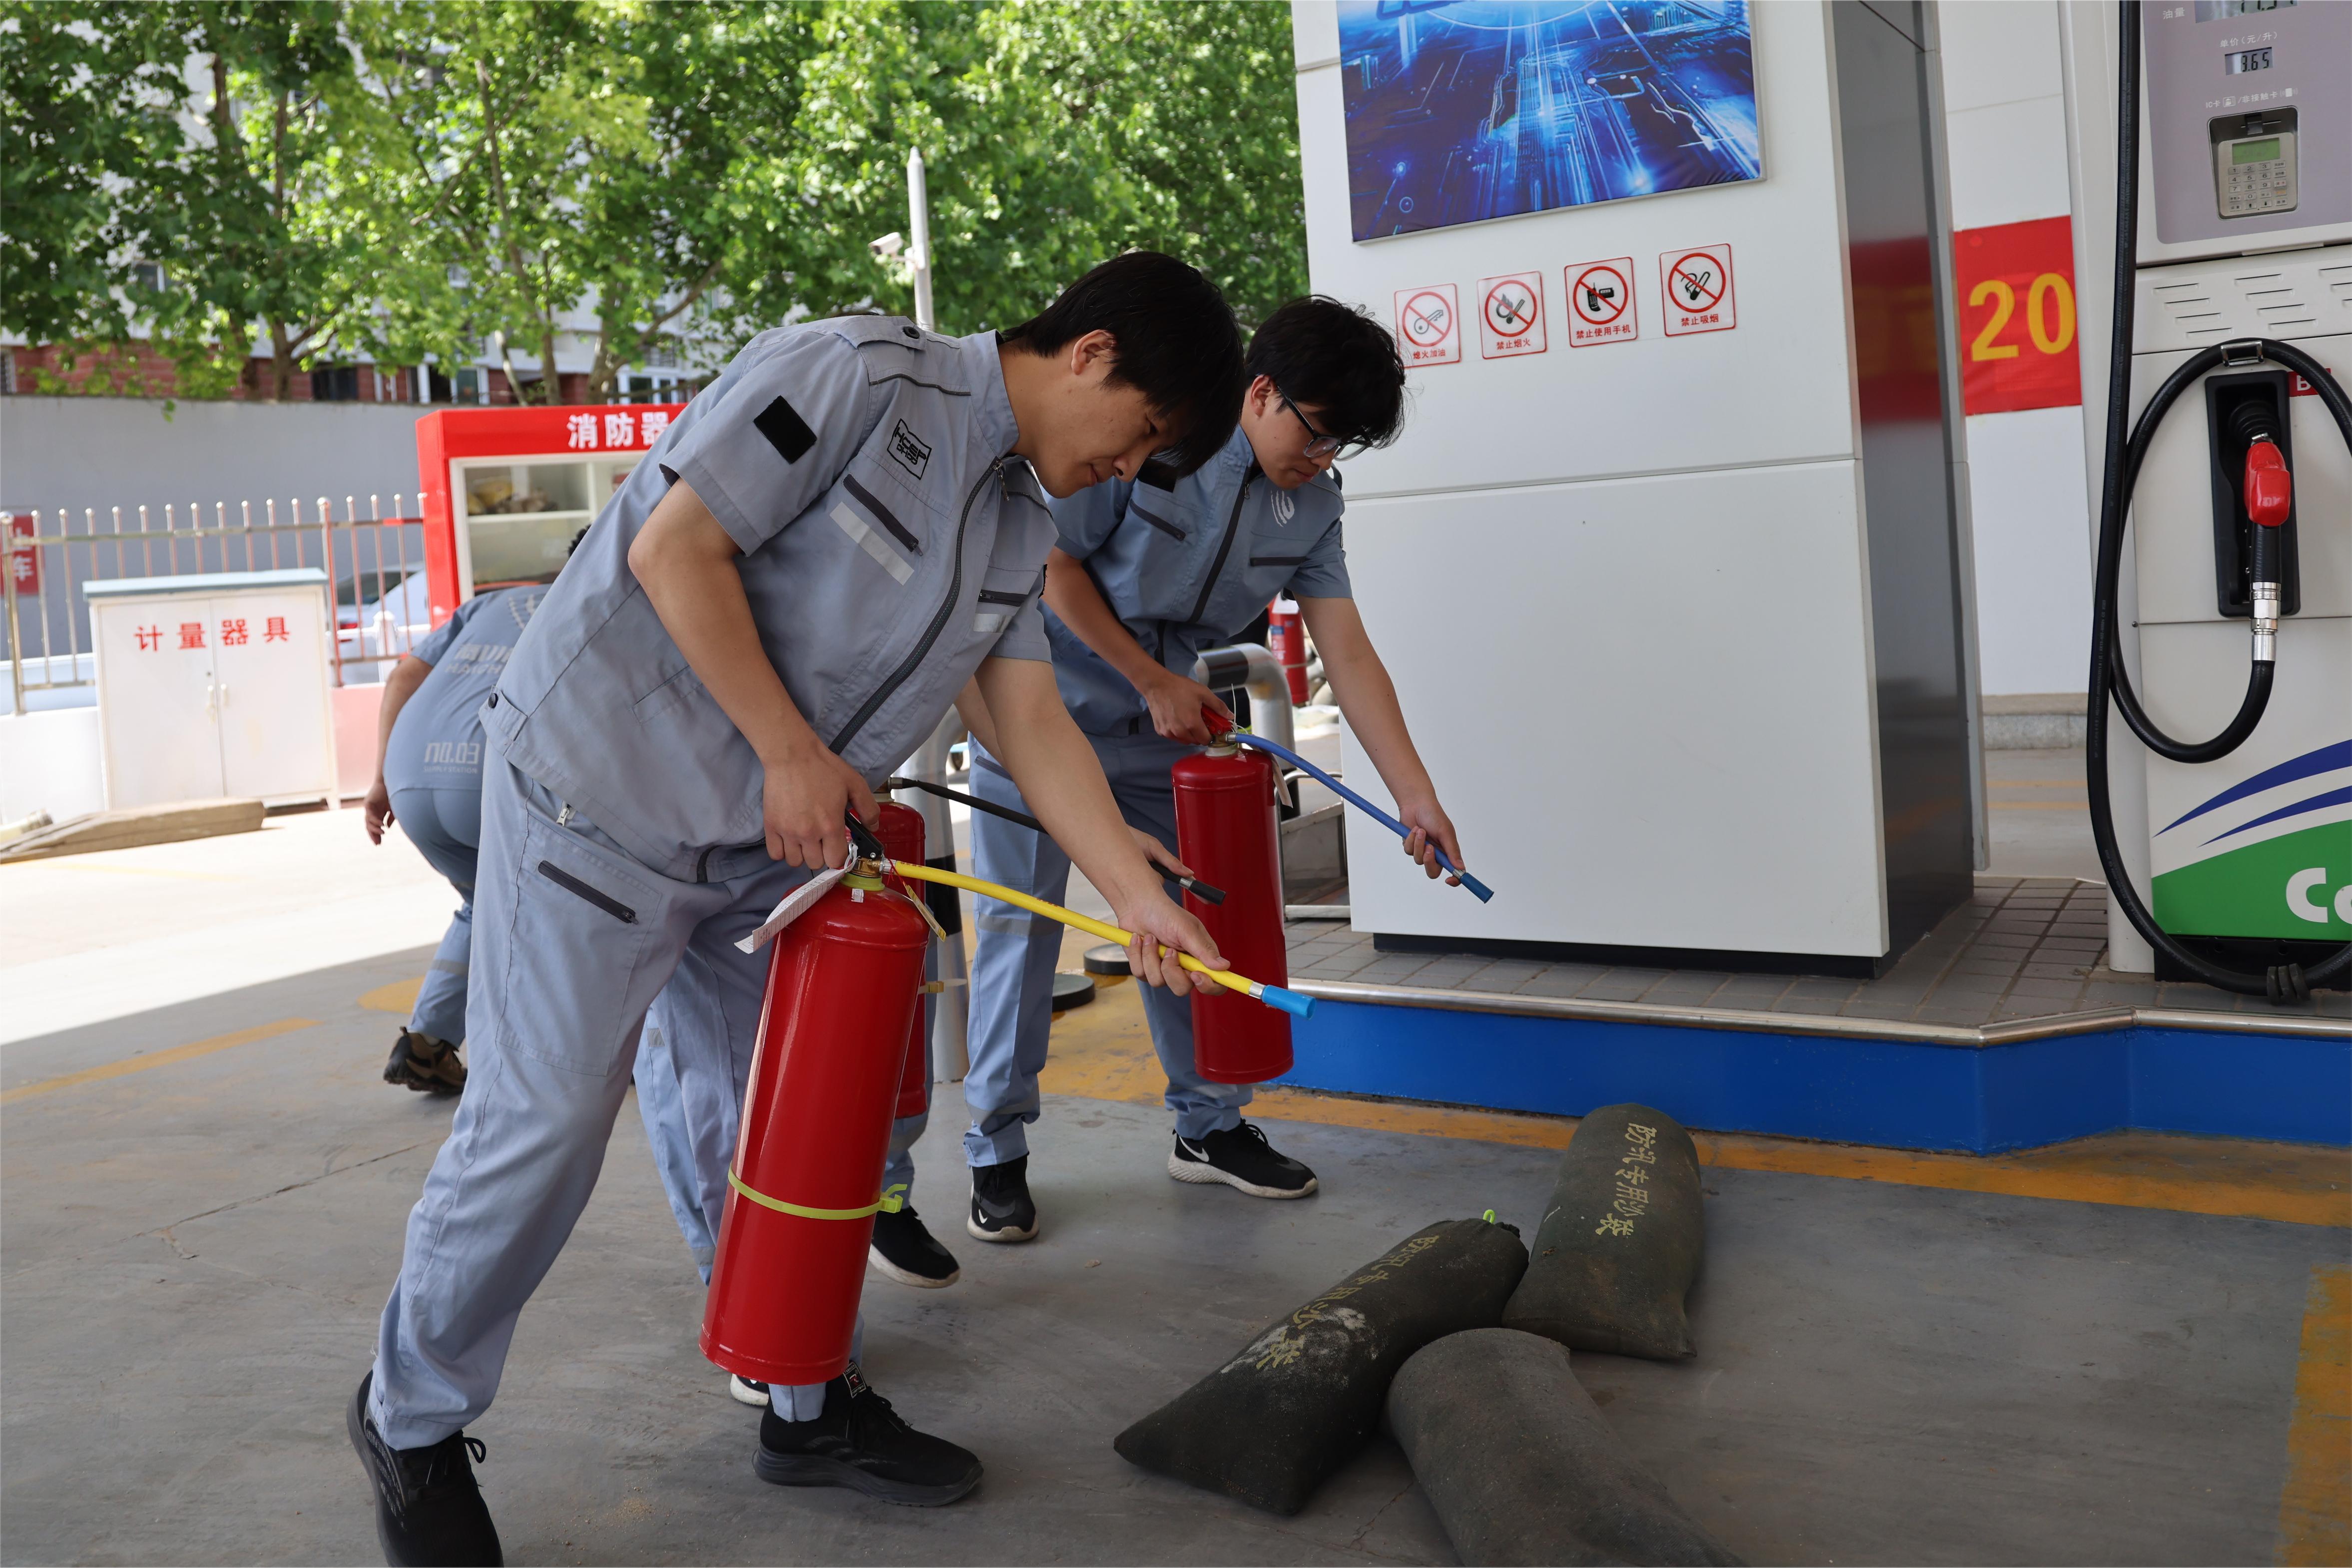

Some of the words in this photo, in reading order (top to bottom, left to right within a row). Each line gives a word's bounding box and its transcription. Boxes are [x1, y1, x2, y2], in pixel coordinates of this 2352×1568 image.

[2163, 7, 2185, 19] 油量
[1681, 313, 1719, 327] 禁止吸烟
[1968, 272, 2076, 362] 20
[1576, 324, 1631, 339] 禁止使用手机
[1496, 338, 1531, 350] 禁止烟火
[1412, 348, 1446, 360] 熄火加油
[894, 427, 927, 460] HCEP
[133, 616, 291, 651] 计量器具
[1595, 1123, 1658, 1236] 防汛专用沙袋
